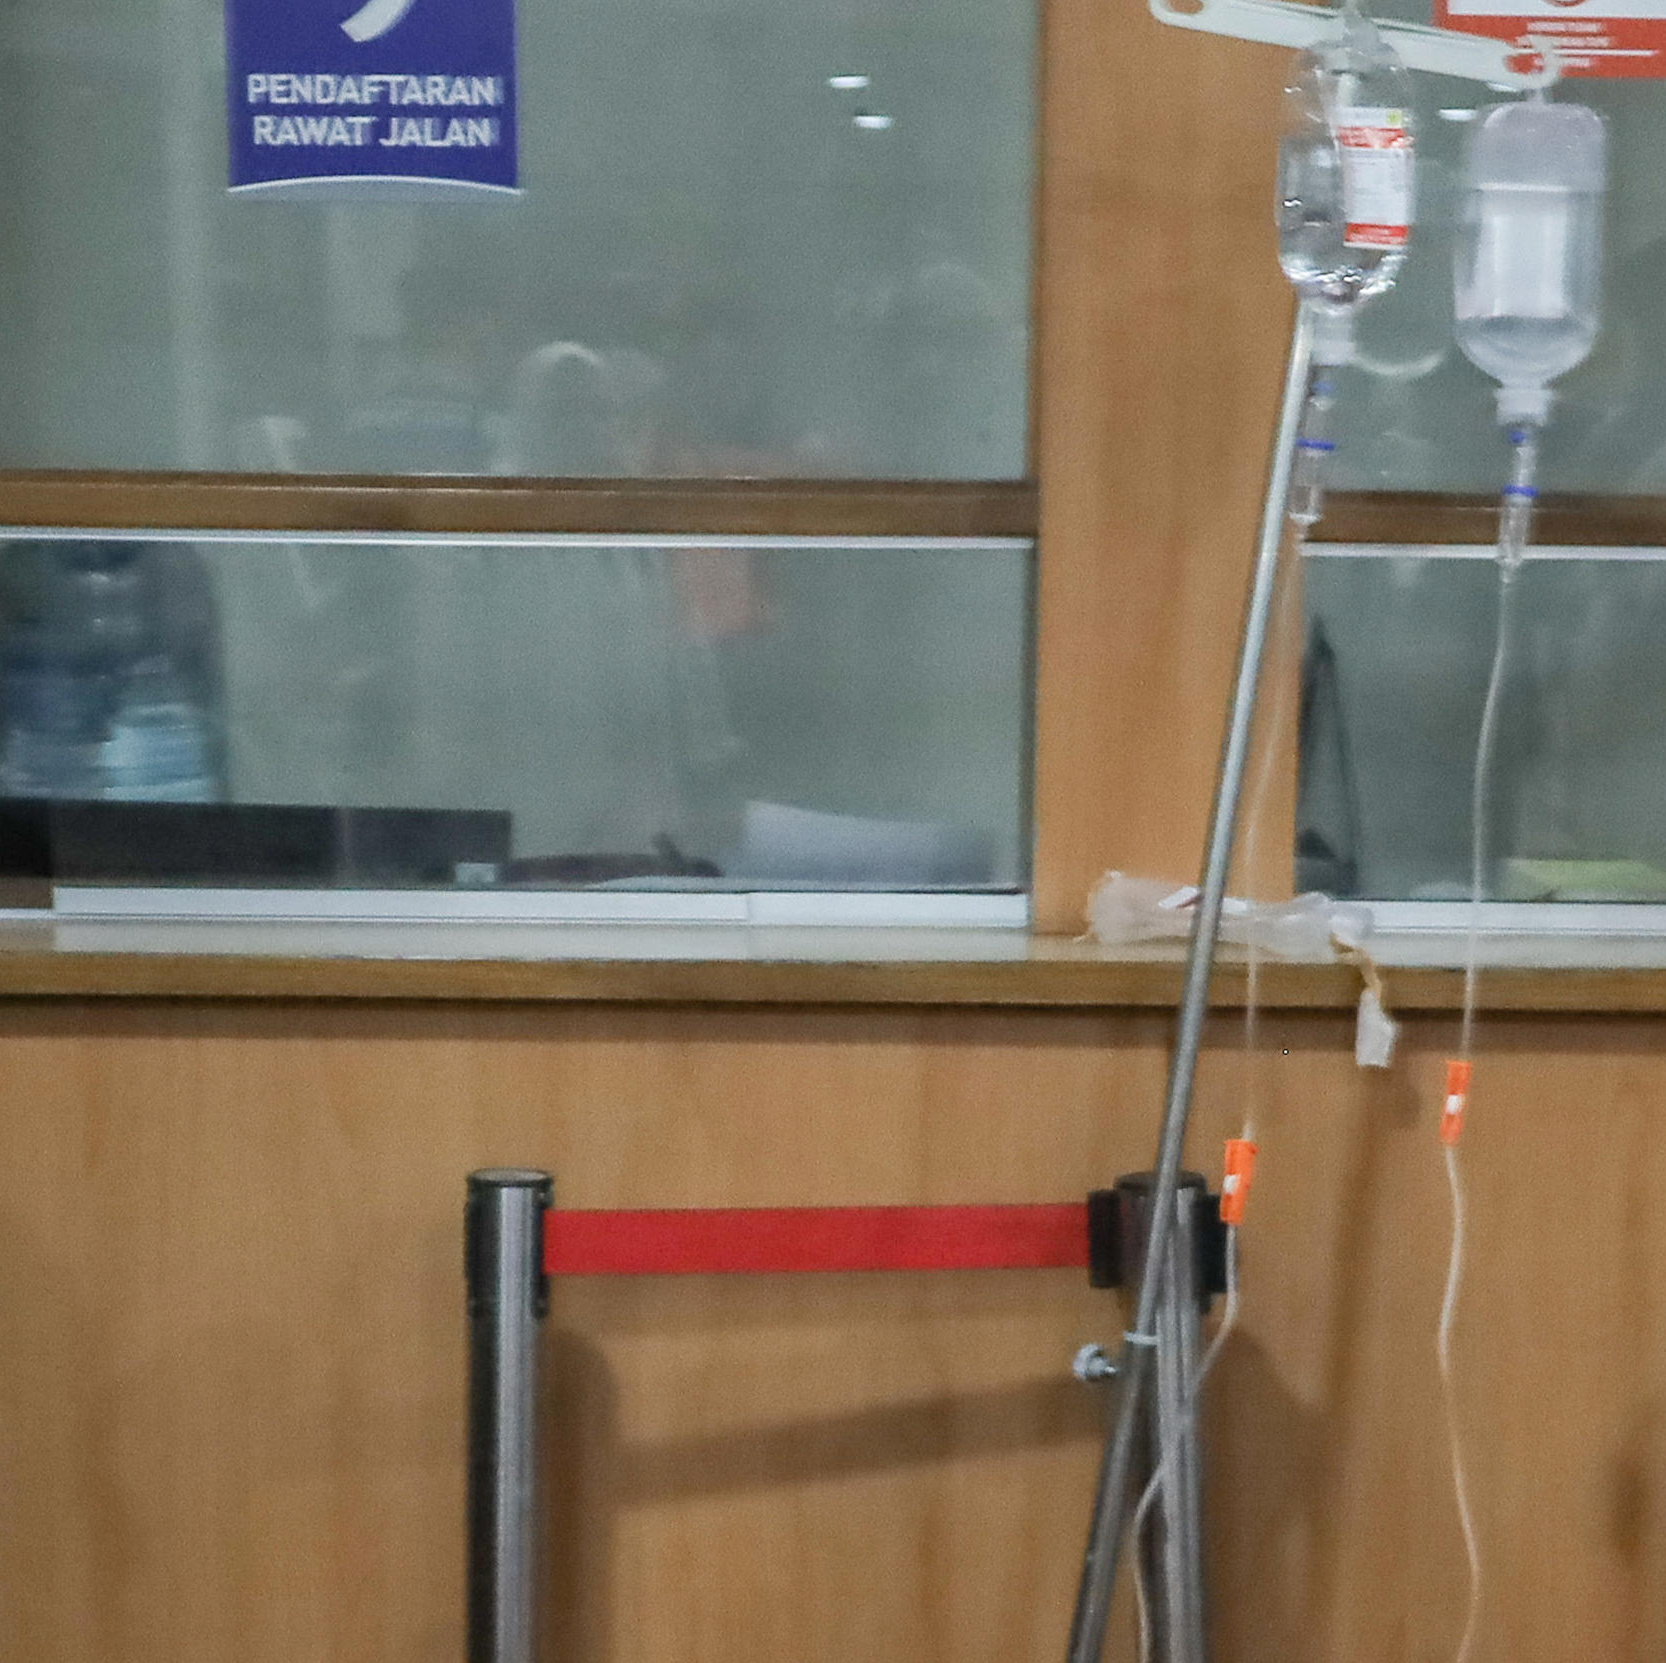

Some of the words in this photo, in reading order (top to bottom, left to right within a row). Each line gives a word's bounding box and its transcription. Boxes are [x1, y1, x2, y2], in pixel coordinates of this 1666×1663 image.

[246, 73, 500, 106] PENDAFTARAN
[253, 115, 376, 147] RAWAT
[379, 116, 498, 148] JALAN
